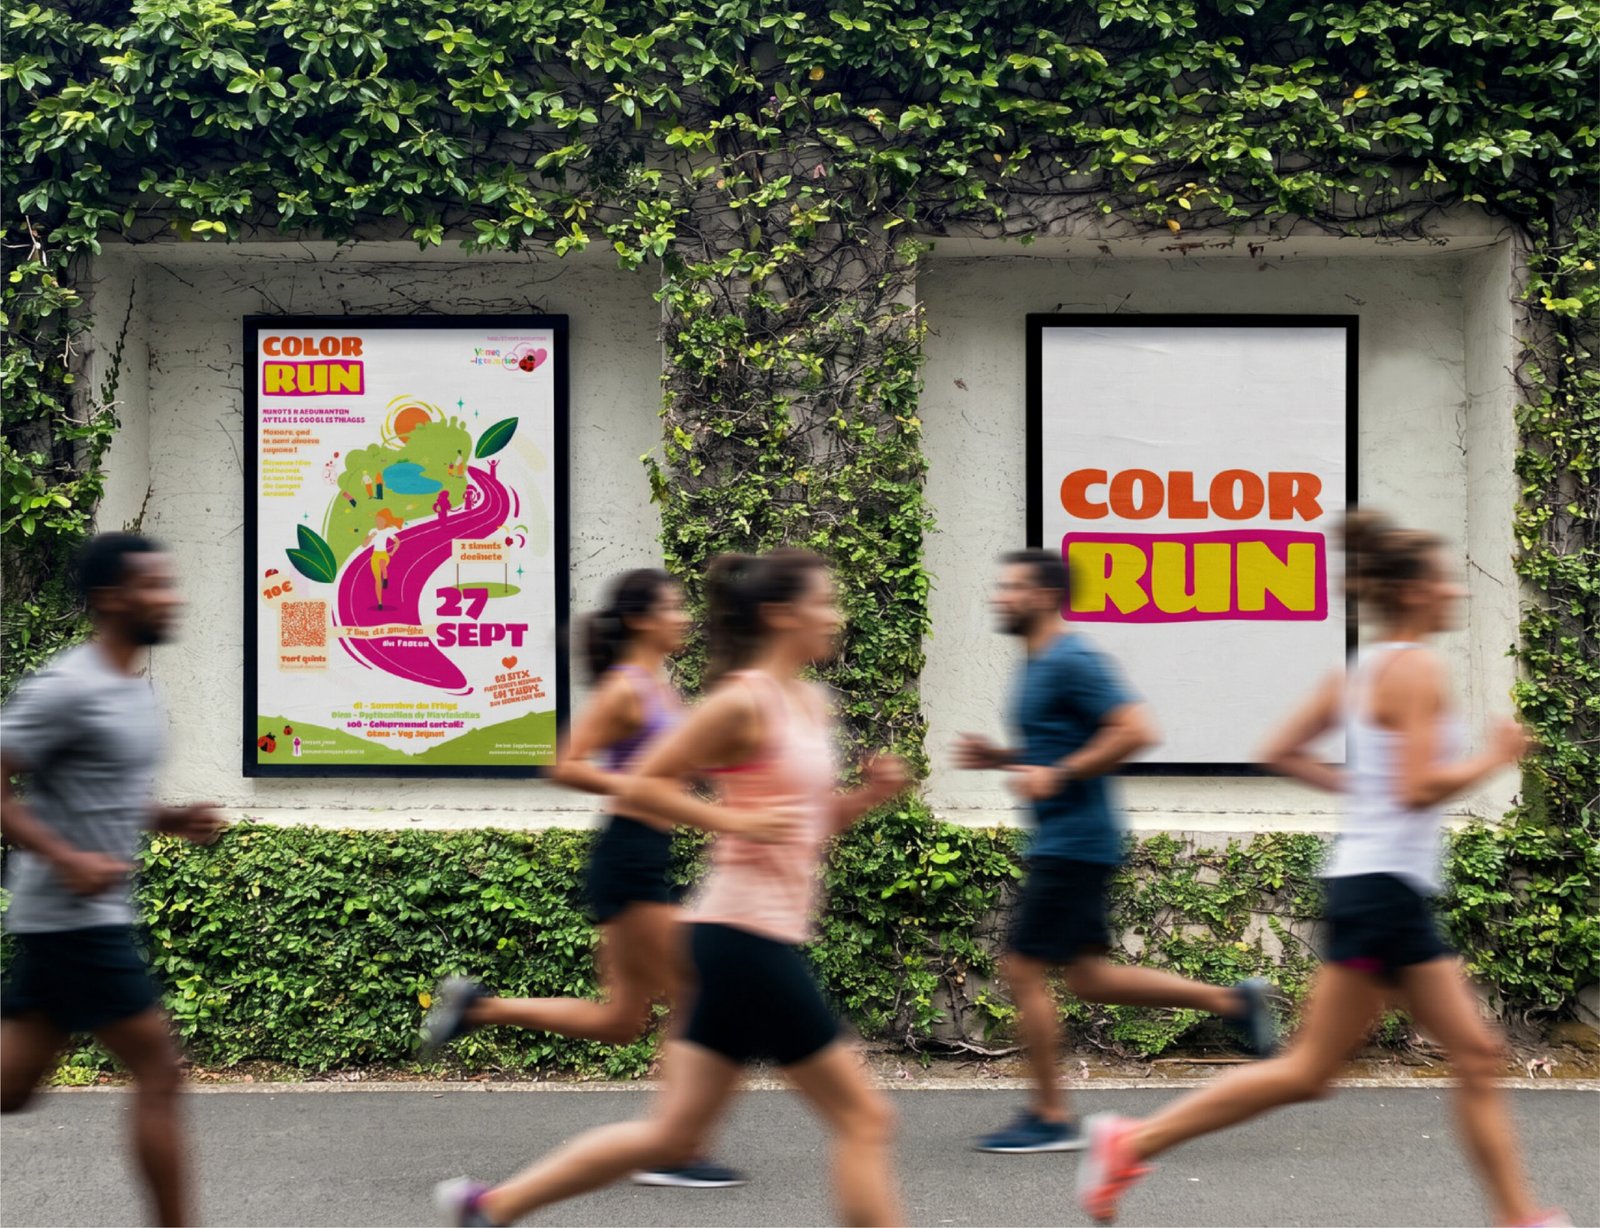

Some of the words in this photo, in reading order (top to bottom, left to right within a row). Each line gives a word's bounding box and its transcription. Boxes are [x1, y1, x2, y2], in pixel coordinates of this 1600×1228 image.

[262, 335, 363, 357] COLOR
[264, 363, 361, 393] RUN
[1060, 468, 1324, 522] COLOR
[1068, 541, 1316, 614] RUN
[436, 587, 489, 621] 27
[436, 622, 528, 647] SEPT
